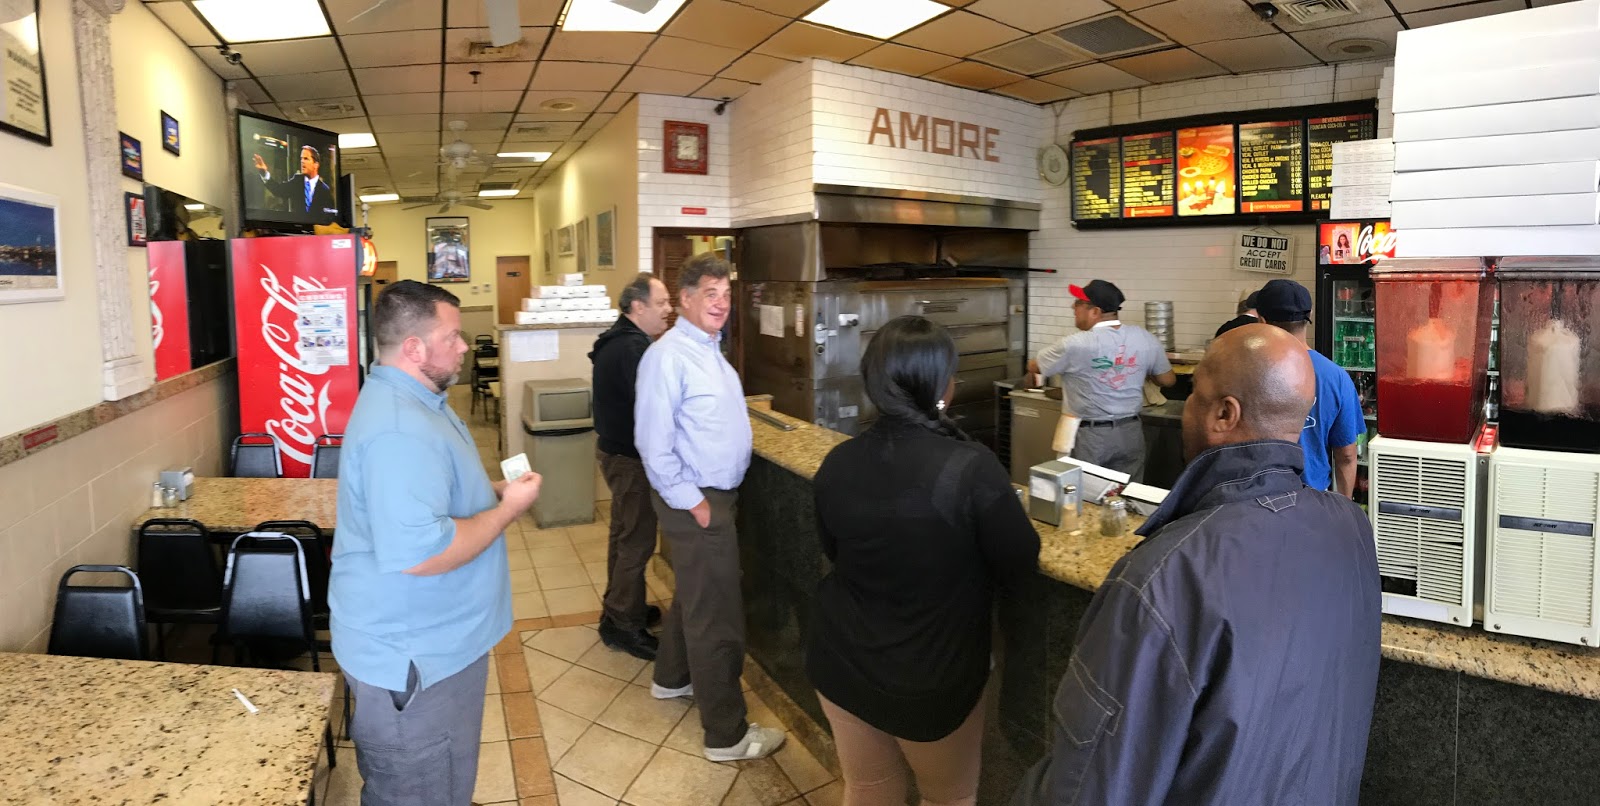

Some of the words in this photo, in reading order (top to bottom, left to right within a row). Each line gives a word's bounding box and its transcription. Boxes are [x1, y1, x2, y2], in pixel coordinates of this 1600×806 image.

[868, 107, 1000, 163] AMORE
[1243, 236, 1256, 246] WE
[1256, 237, 1268, 248] DO
[1271, 238, 1286, 250] NOT
[1246, 250, 1281, 258] ACCEPT
[1240, 257, 1262, 268] CREDIT
[1265, 259, 1286, 270] CARDS
[260, 263, 330, 464] Coca-Cla
